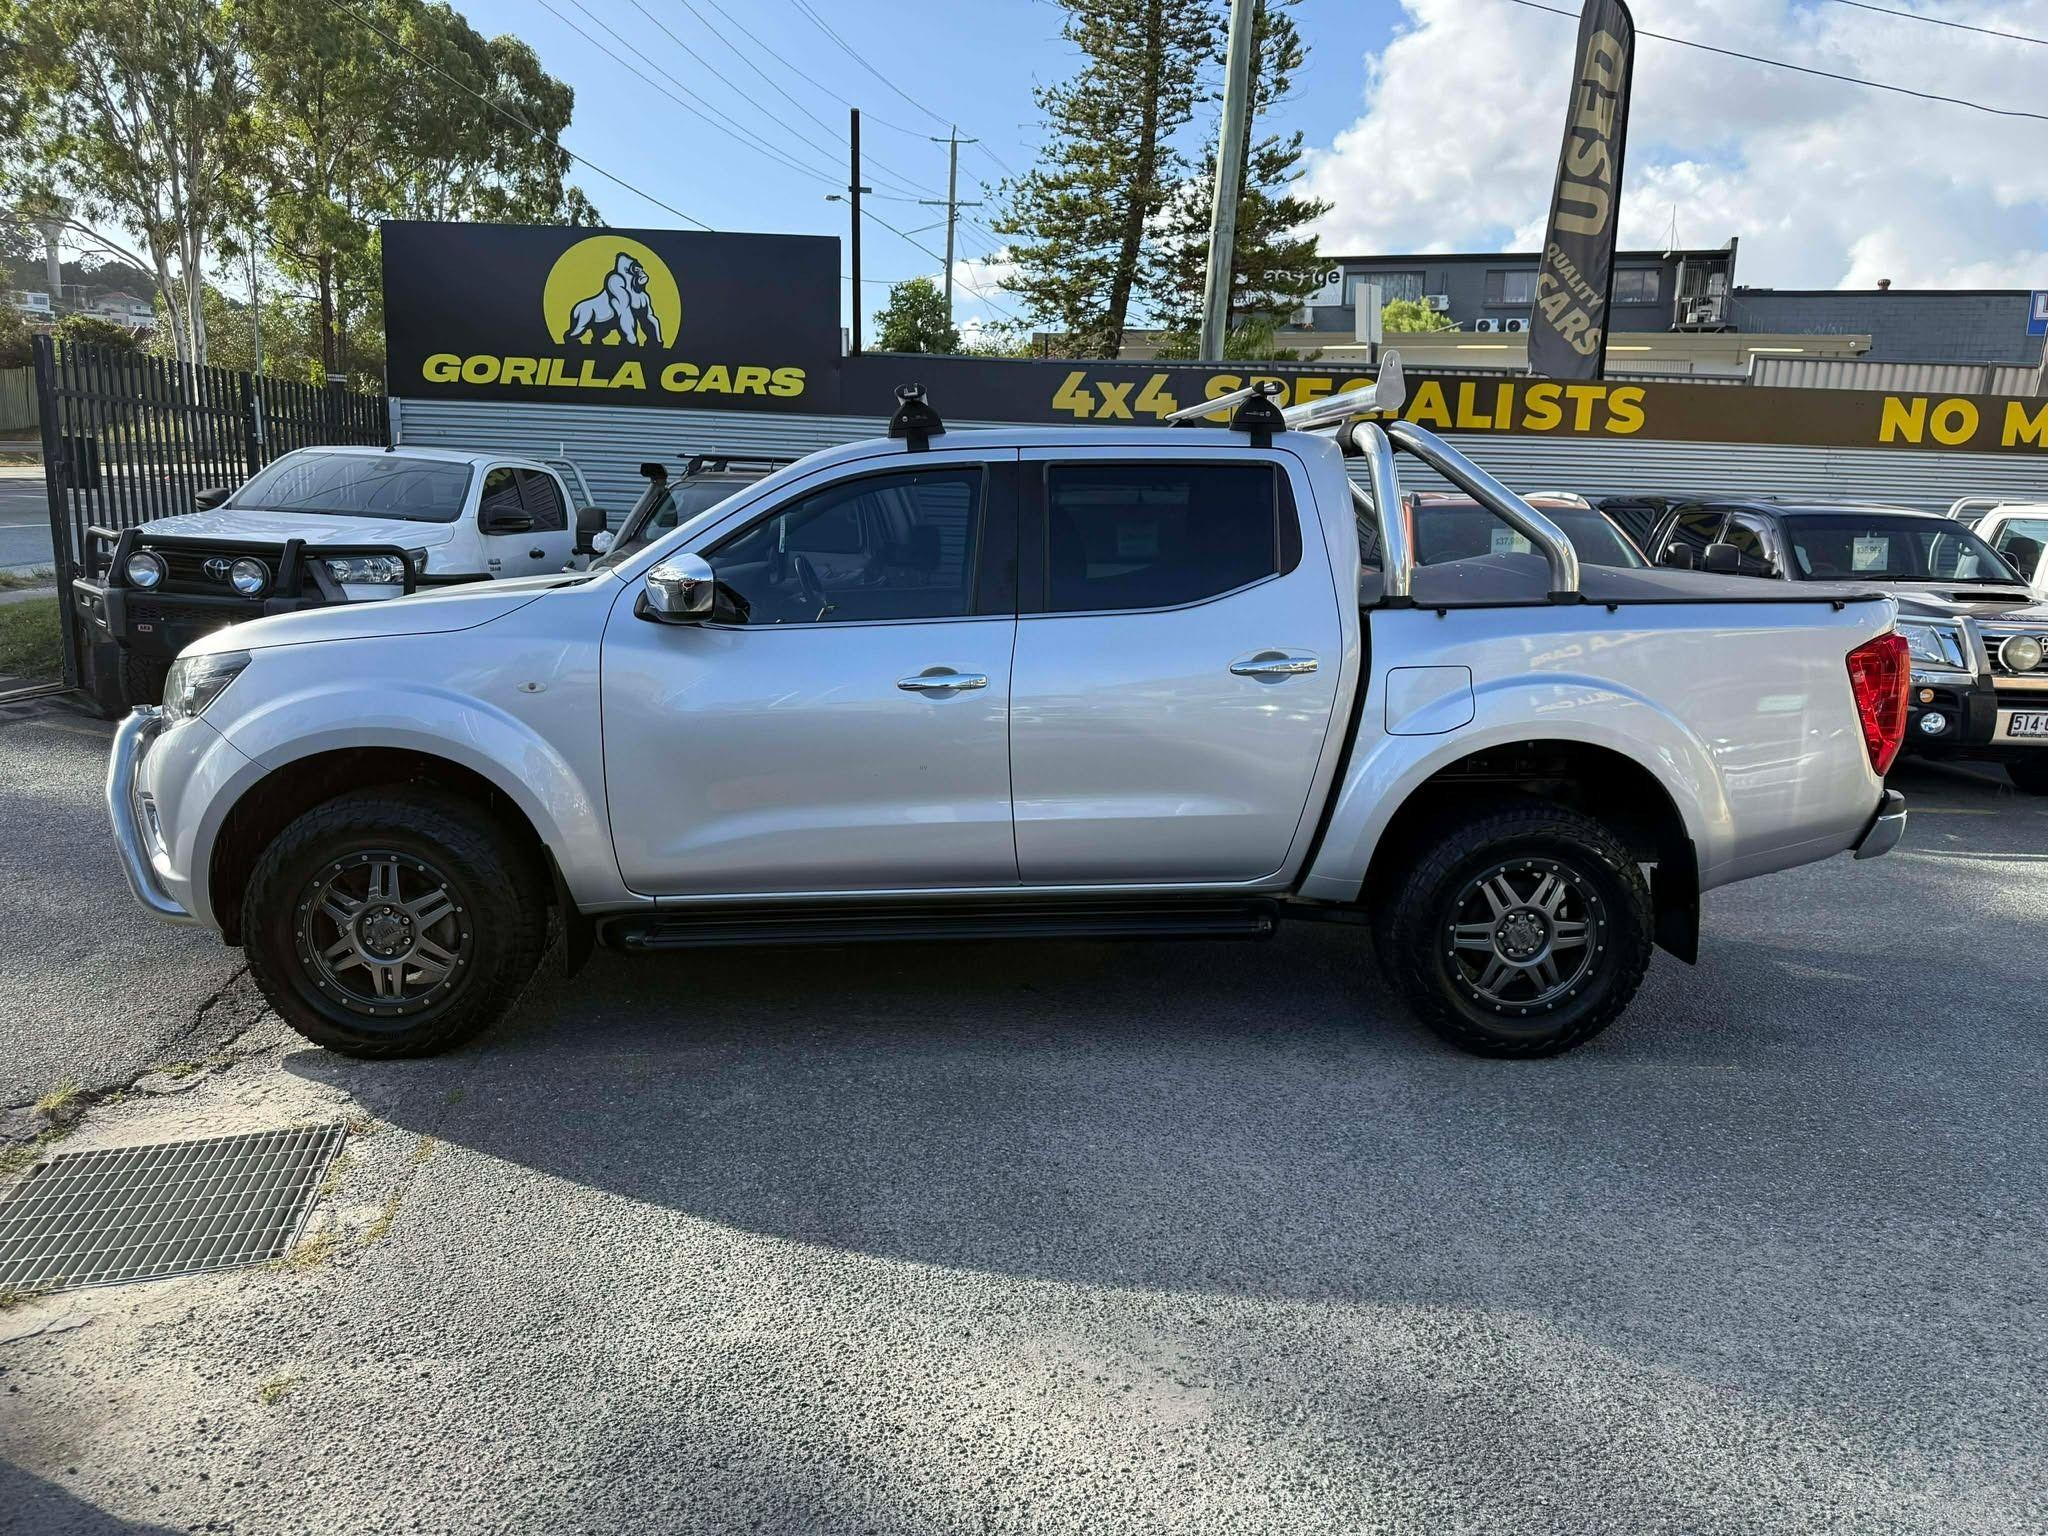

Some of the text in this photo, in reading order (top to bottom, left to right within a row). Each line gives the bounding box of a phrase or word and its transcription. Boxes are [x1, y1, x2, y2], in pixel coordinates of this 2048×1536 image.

[1555, 30, 1625, 237] USED
[1547, 242, 1604, 308] QUALITY
[1537, 272, 1602, 356] CARS
[421, 353, 807, 397] GORILLA CARS
[1052, 371, 1647, 434] 4x4 SPEALISTS
[1879, 396, 1980, 446] NO
